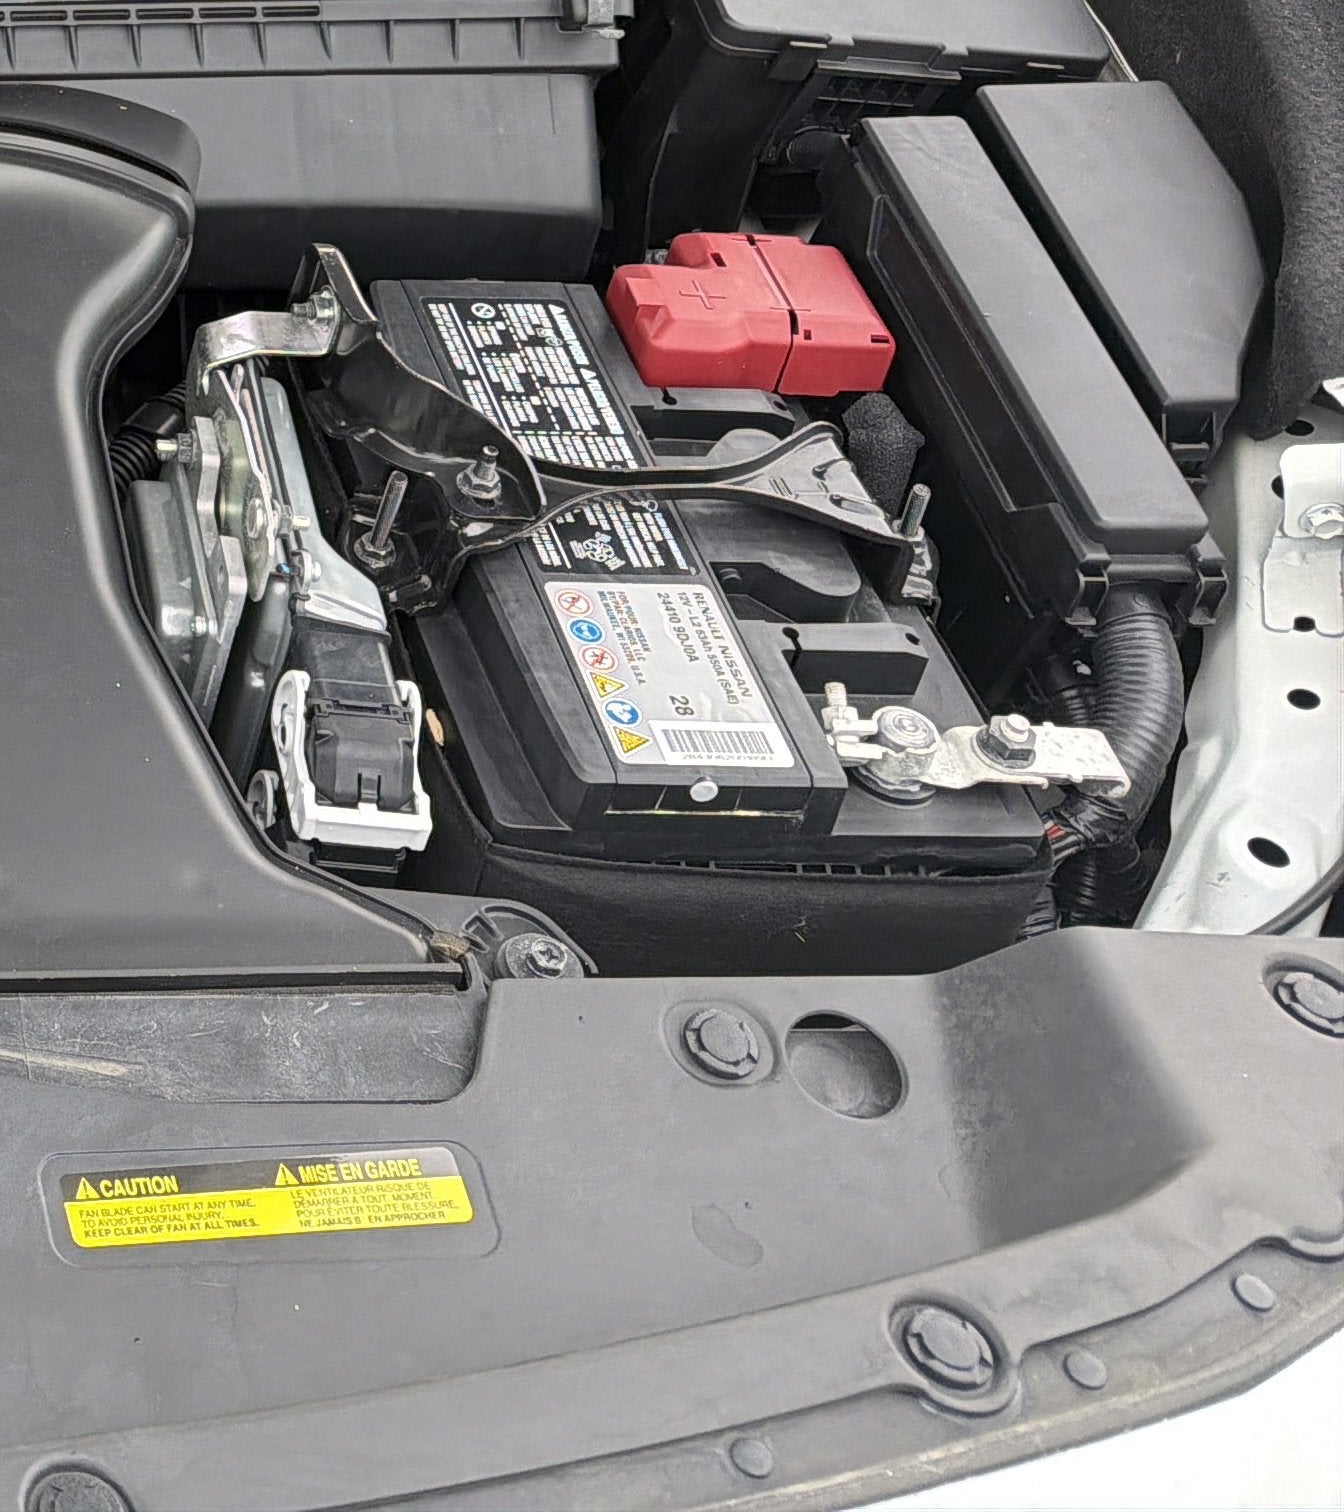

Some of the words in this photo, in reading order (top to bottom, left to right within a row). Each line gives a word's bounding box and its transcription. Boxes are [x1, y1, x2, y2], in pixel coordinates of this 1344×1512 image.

[656, 592, 681, 624] 24410
[633, 627, 652, 652] NISSAN
[676, 591, 693, 607] 12V
[687, 615, 701, 628] L2
[694, 629, 712, 652] 63Ah
[706, 653, 724, 676] 550A
[717, 677, 739, 705] (SAE)
[692, 591, 726, 641] RENAULT
[718, 644, 754, 699] NISSAN
[668, 694, 695, 717] 28
[298, 1163, 339, 1184] MISE
[341, 1161, 364, 1182] EN
[364, 1158, 423, 1179] GARDE
[99, 1175, 179, 1198] CAUTION
[290, 1189, 303, 1199] LE
[304, 1184, 375, 1198] VENTILATEUR
[376, 1182, 416, 1193] RISQUE
[417, 1181, 432, 1190] DE
[78, 1208, 99, 1219] FAN
[101, 1207, 134, 1218] BLADE
[136, 1205, 158, 1216] CAN
[159, 1203, 191, 1214] START
[193, 1202, 205, 1212] AT
[207, 1200, 227, 1211] ANY
[296, 1207, 325, 1218] POUR
[366, 1202, 399, 1213] TOUTE
[361, 1193, 388, 1204] TOUT
[81, 1218, 96, 1228] TO
[98, 1217, 128, 1228] AVOID
[130, 1214, 184, 1226] PERSONAL
[84, 1228, 112, 1238] KEEP
[113, 1226, 148, 1236] CLEAR
[150, 1224, 165, 1235] OF
[166, 1223, 188, 1233] FAN
[189, 1221, 202, 1232] AT
[204, 1220, 224, 1230] ALL
